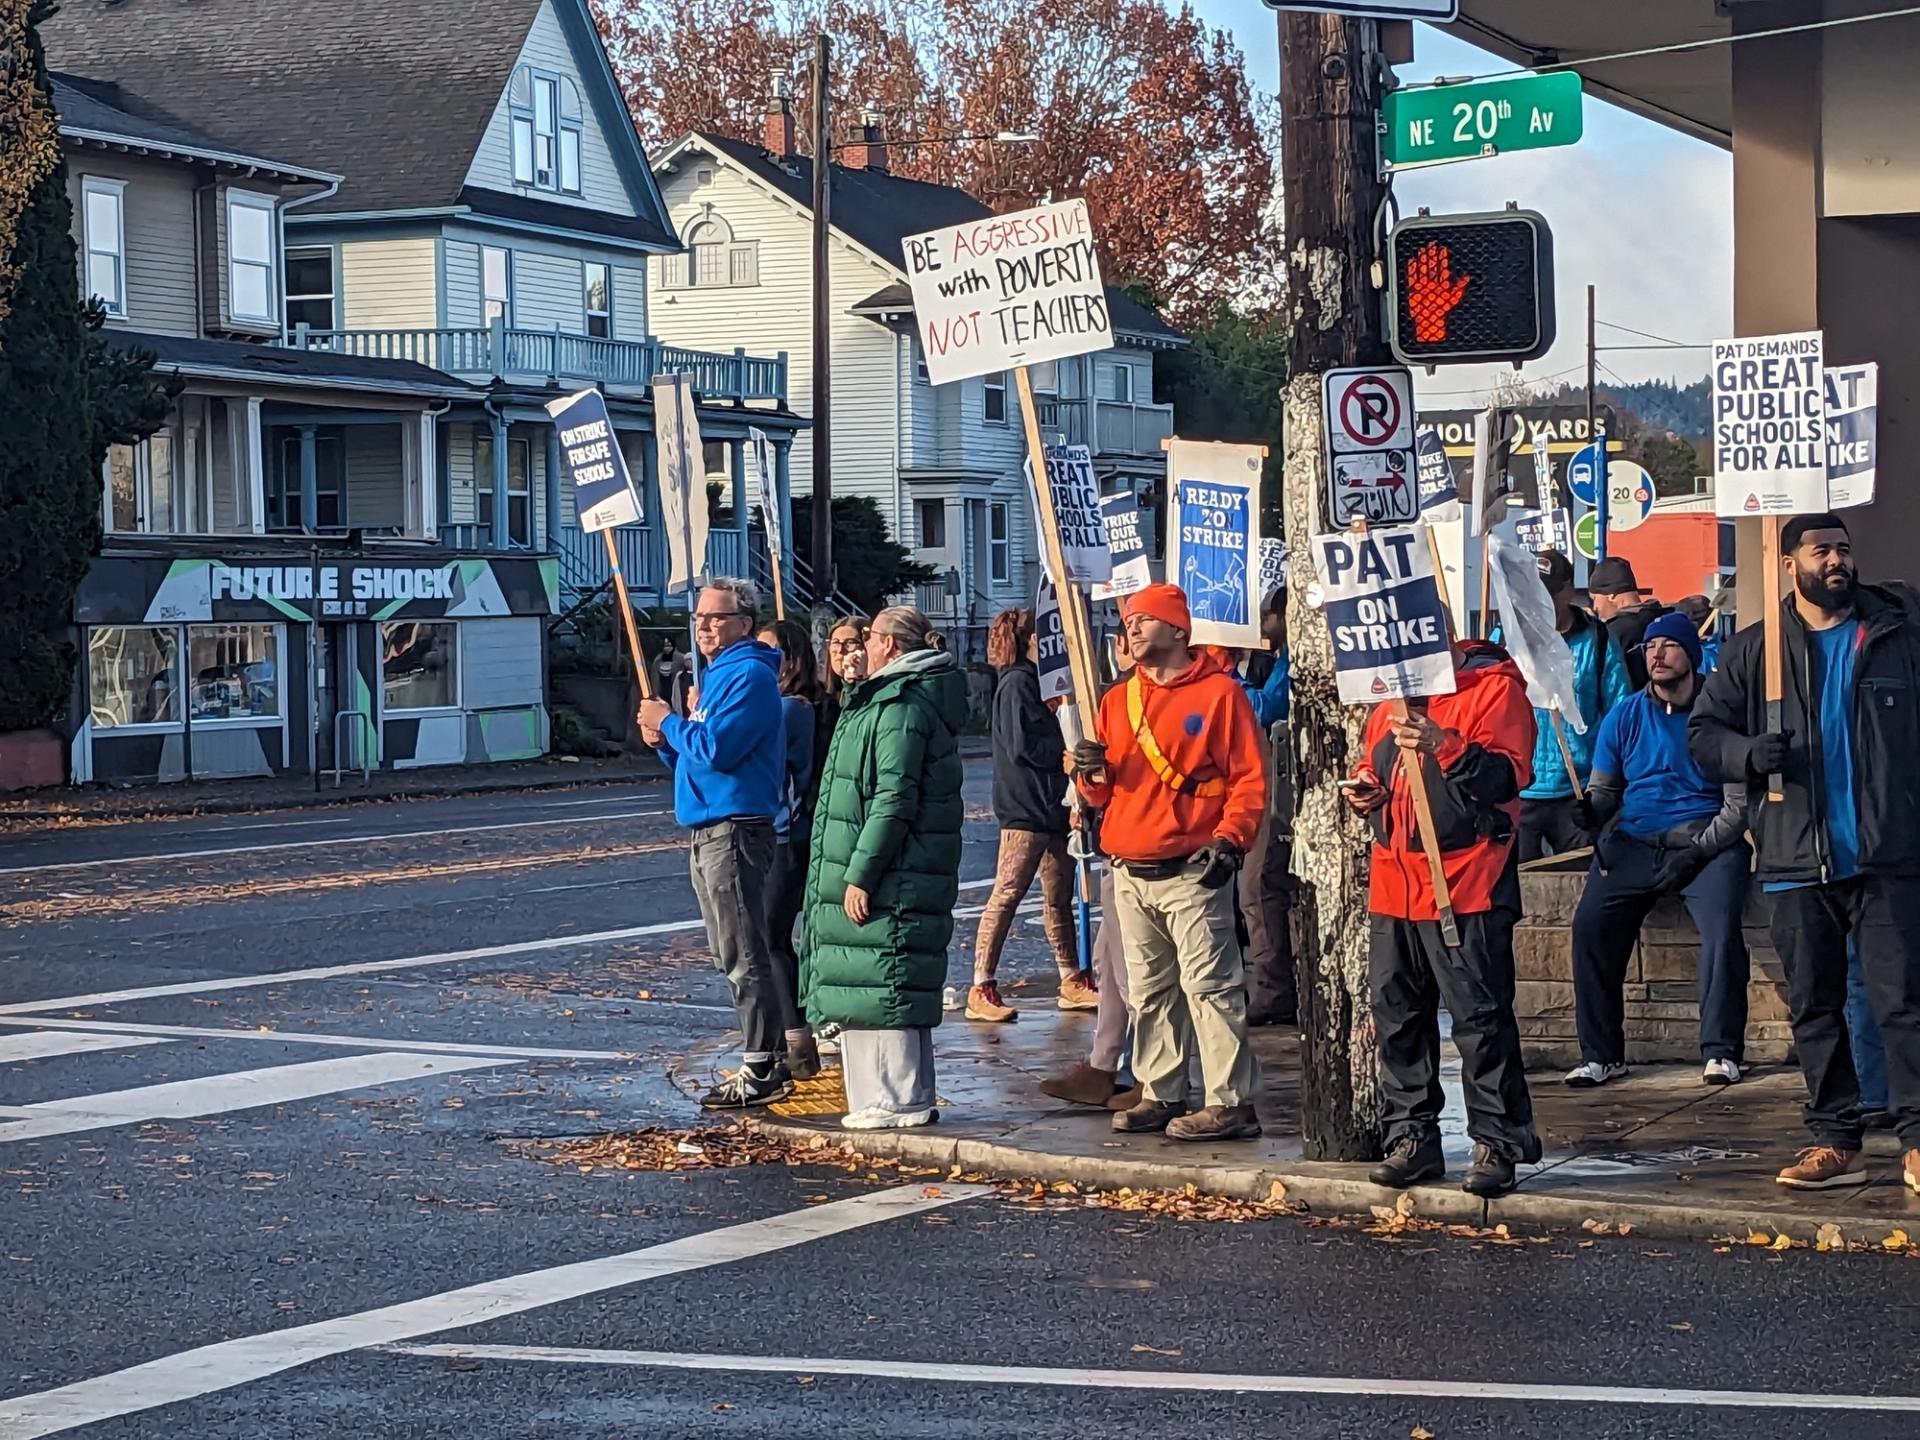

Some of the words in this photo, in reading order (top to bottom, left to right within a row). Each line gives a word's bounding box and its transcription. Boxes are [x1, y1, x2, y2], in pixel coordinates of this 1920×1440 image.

[1409, 119, 1435, 147] NE
[1453, 99, 1512, 142] 20th
[1529, 106, 1554, 134] Av
[937, 268, 990, 298] with
[995, 239, 1096, 298] POVERTY
[929, 311, 981, 355] NOT
[991, 295, 1108, 345] TEACHERS
[1716, 344, 1744, 359] PAT
[1747, 339, 1819, 357] DEMANDS
[1717, 356, 1819, 392] GREAT
[1824, 370, 1866, 410] AT
[1717, 390, 1821, 422] PUBLIC
[1528, 419, 1606, 440] YARDS
[1718, 420, 1822, 446] SCHOOLS
[585, 441, 611, 462] SAFE
[1718, 446, 1768, 472] FOR
[1774, 443, 1822, 469] ALL
[574, 461, 615, 486] SCHOOLS
[1046, 461, 1090, 486] REAT
[1186, 487, 1243, 511] READY
[1613, 487, 1630, 499] 20
[1056, 510, 1102, 527] HOOLS
[1103, 511, 1139, 529] TRIKE
[1076, 529, 1107, 547] ALL
[1111, 525, 1137, 541] OUR
[1183, 526, 1244, 550] STRIKE
[1323, 534, 1416, 585] PAT
[212, 567, 339, 599] FUTURE
[352, 568, 454, 599] SHOCK
[1357, 596, 1399, 625] ON
[1335, 616, 1439, 652] STRIKE
